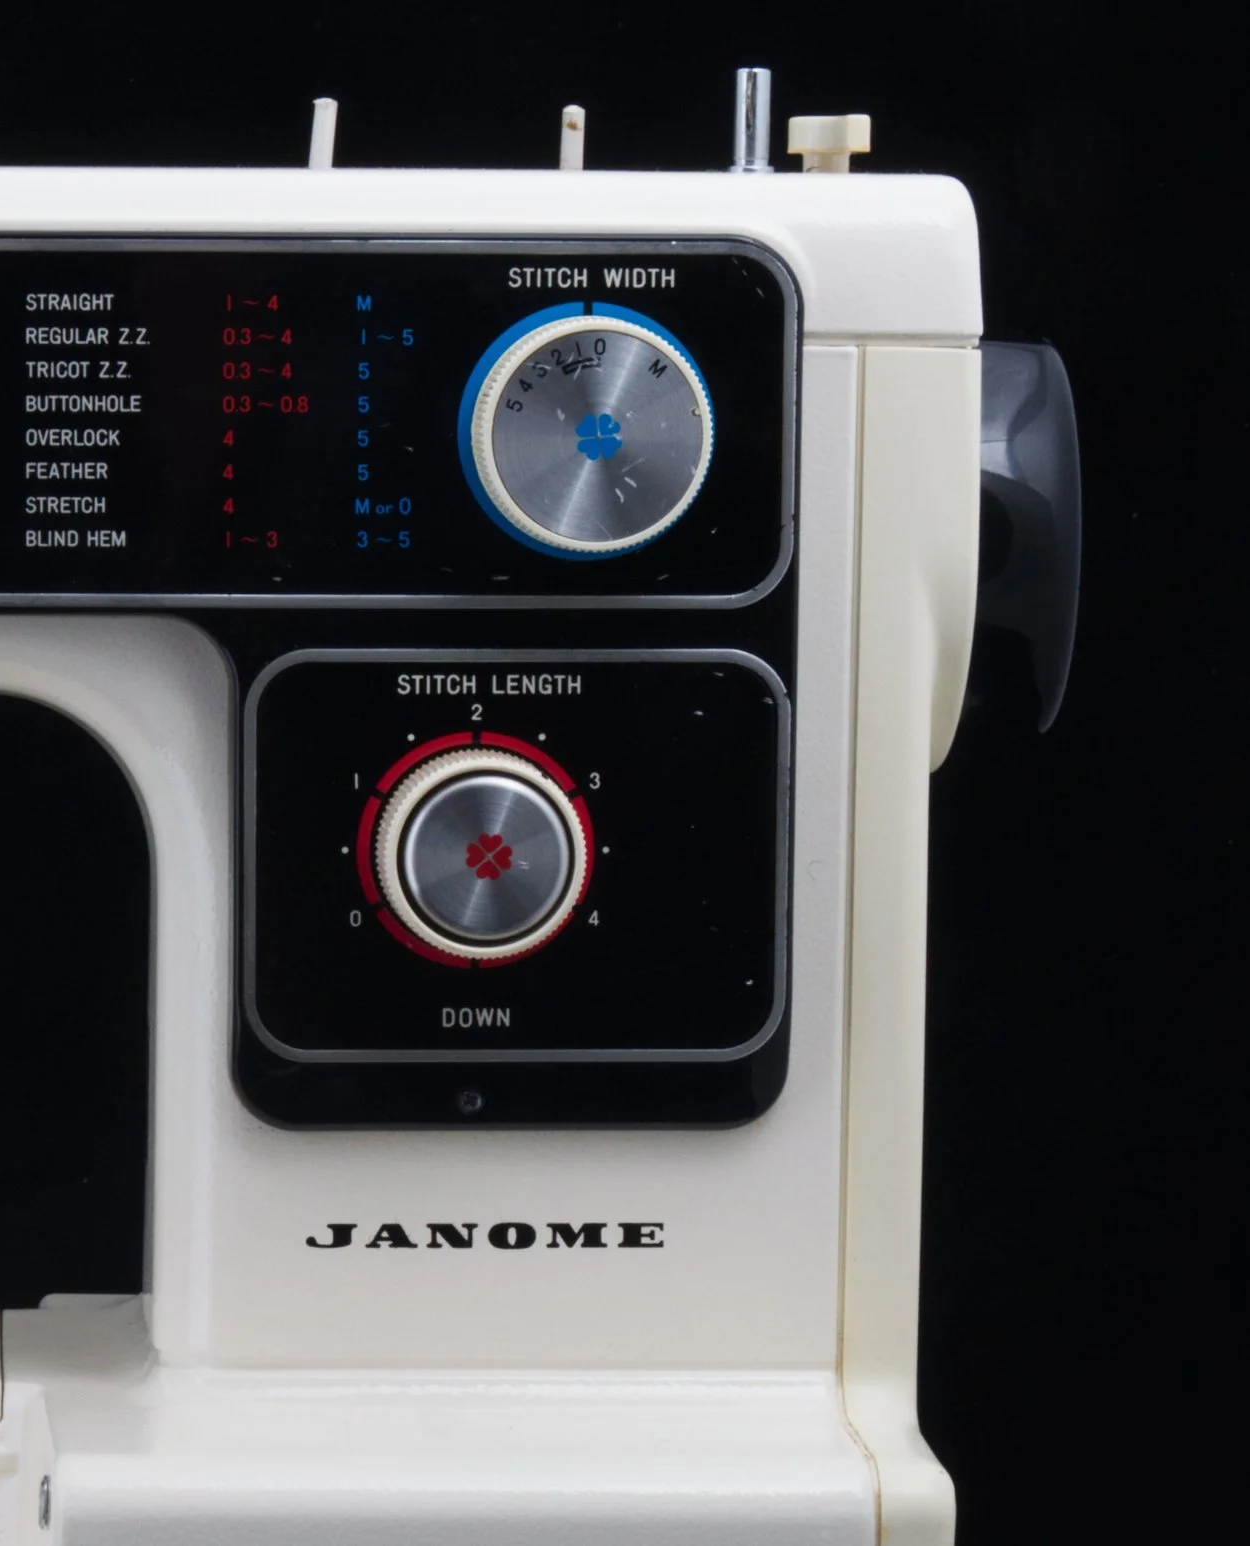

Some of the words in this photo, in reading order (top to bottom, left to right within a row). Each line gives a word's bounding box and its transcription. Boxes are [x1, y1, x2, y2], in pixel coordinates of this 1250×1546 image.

[508, 267, 588, 289] STITCH
[603, 267, 675, 289] WIDTH
[25, 292, 115, 312] STRAIGHT
[266, 294, 279, 312] 4
[356, 294, 372, 311] M
[25, 326, 109, 345] REGULAR
[118, 327, 150, 345] Z.Z.
[222, 327, 252, 346] 0.3
[281, 328, 293, 346] 4
[402, 329, 414, 346] 5
[594, 338, 607, 356] 0
[551, 348, 565, 366] 2
[25, 360, 90, 379] TRICOT
[98, 360, 131, 379] Z.Z.
[222, 362, 252, 380] 0.3
[281, 362, 293, 380] 4
[358, 362, 370, 380] 5
[648, 358, 668, 379] M
[518, 378, 534, 393] 4
[25, 394, 142, 413] BUTTONHOLE
[222, 395, 252, 413] 0.3
[280, 395, 309, 413] 0.8
[358, 396, 370, 413] 5
[506, 398, 524, 413] 5
[25, 428, 120, 447] OVERLOCK
[223, 430, 234, 447] 4
[357, 430, 369, 447] 5
[25, 462, 108, 480] FEATHER
[223, 463, 234, 480] 4
[357, 464, 369, 481] 5
[25, 496, 106, 514] STRETCH
[223, 497, 234, 514] 4
[355, 498, 370, 514] M
[375, 504, 394, 515] or
[25, 529, 79, 548] BLIND
[87, 530, 126, 548] HEM
[266, 530, 278, 548] 3
[357, 531, 368, 548] 3
[399, 531, 410, 548] 5
[397, 674, 476, 695] STITCH
[492, 673, 581, 695] LENGTH
[471, 703, 483, 721] 2
[589, 772, 601, 790] 3
[350, 910, 361, 927] 0
[588, 910, 599, 926] 4
[442, 1007, 510, 1028] DOWN
[305, 1222, 664, 1250] JANOME
